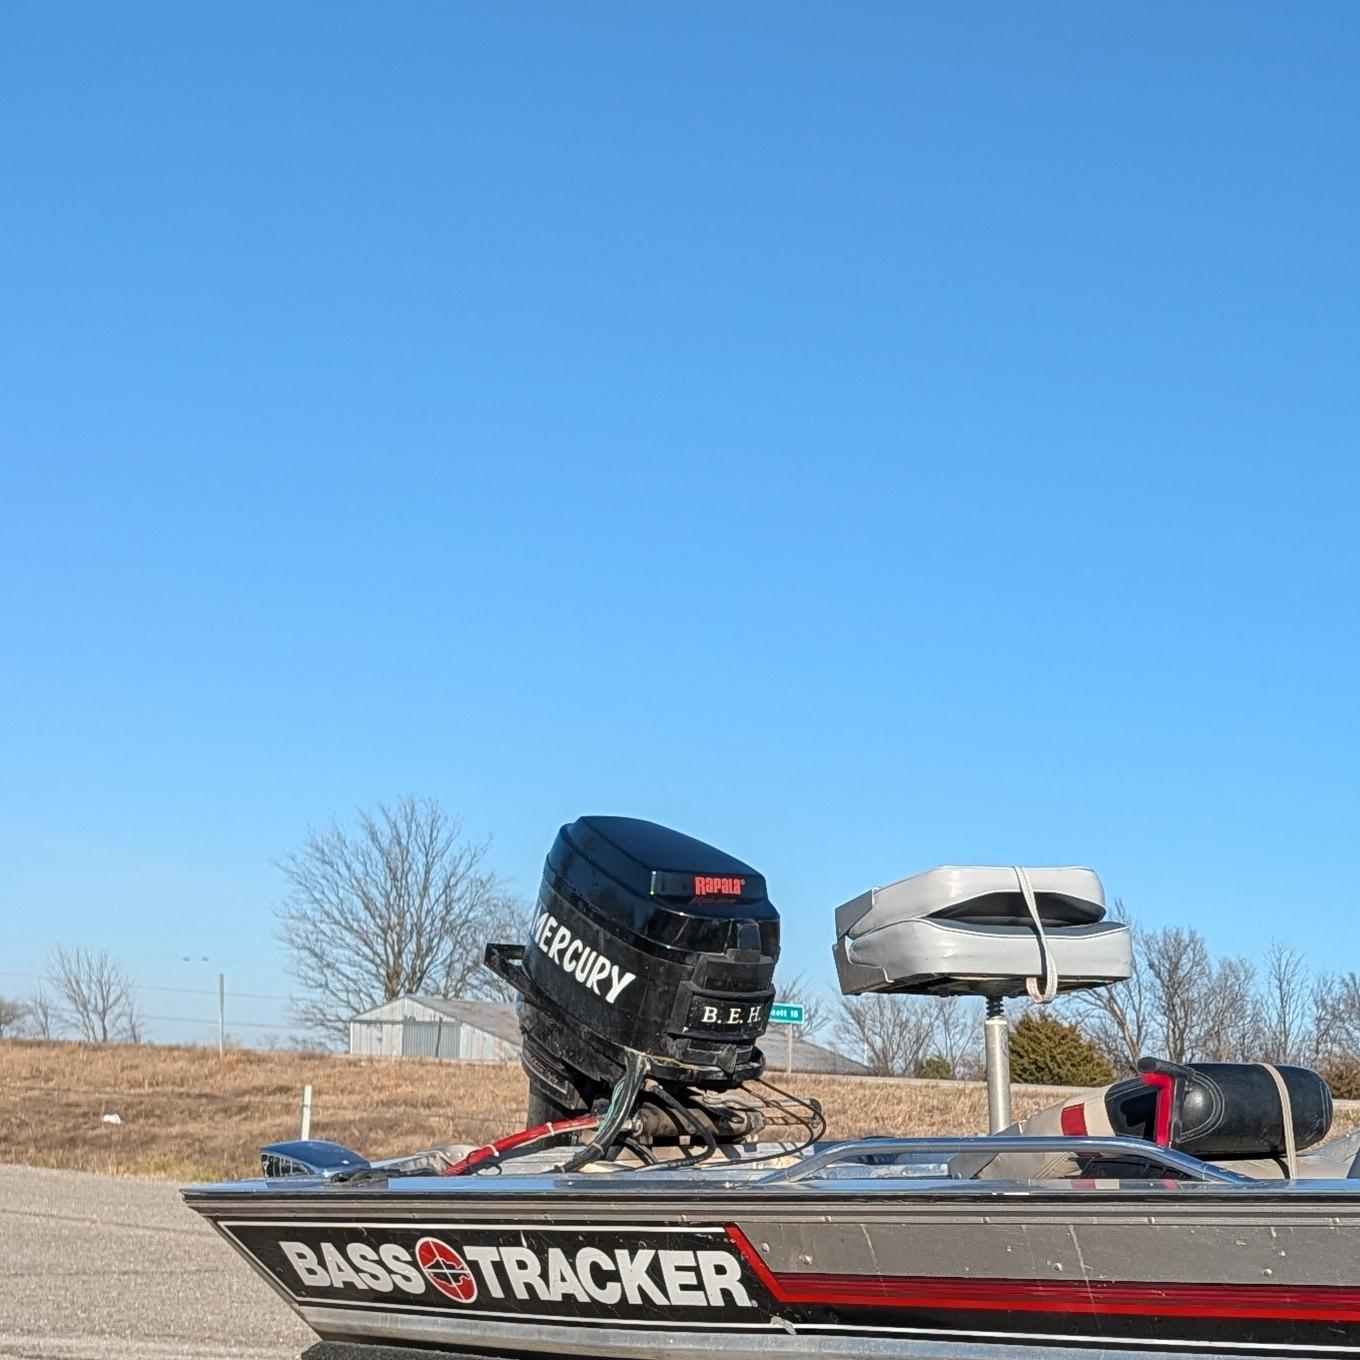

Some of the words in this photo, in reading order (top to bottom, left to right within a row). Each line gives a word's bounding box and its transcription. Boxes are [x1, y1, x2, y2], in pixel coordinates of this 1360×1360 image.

[532, 907, 637, 1004] MERCURY
[279, 1240, 426, 1295] BASS
[463, 1245, 752, 1307] TRACKER
